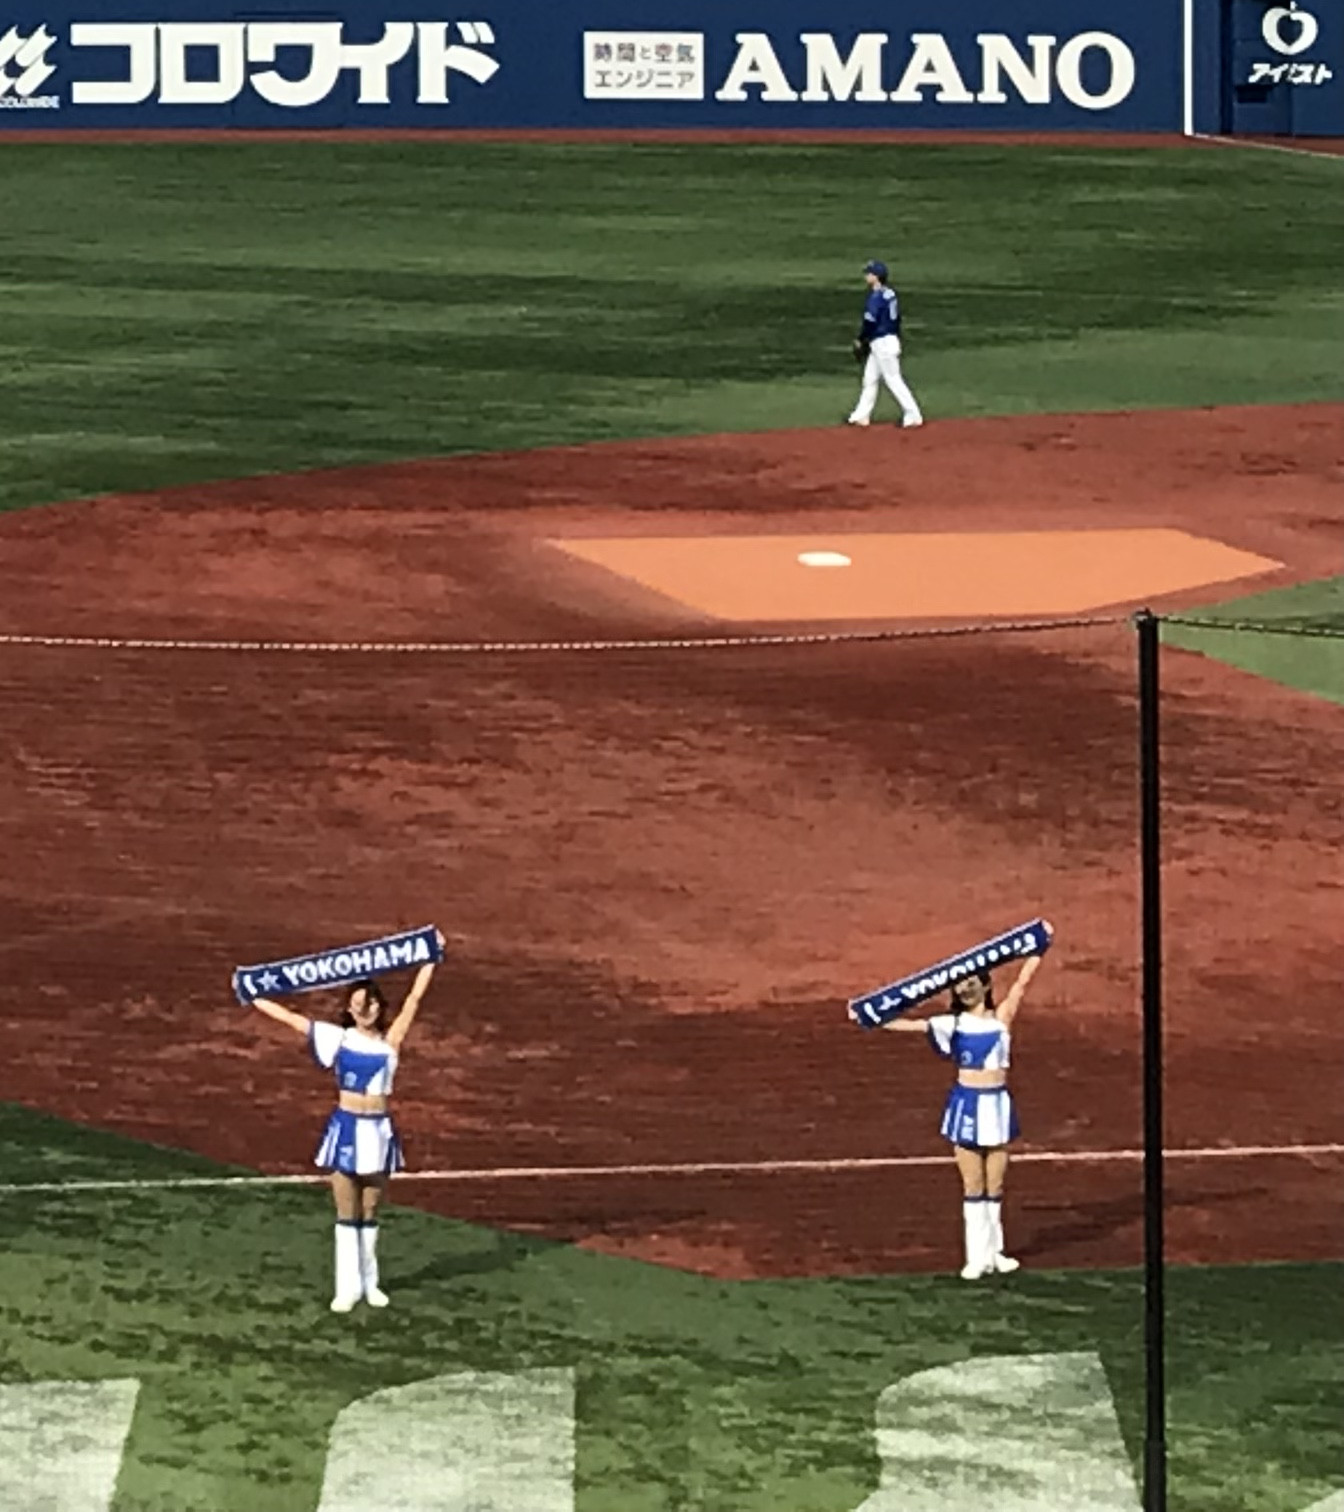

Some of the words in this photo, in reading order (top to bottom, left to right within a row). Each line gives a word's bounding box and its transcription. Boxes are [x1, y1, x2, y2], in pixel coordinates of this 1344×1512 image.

[69, 21, 500, 107] コロワイド
[592, 42, 696, 65] 時間と空気
[714, 30, 1136, 110] AMANO
[593, 68, 695, 90] エンジニア
[282, 937, 431, 986] YOKOHAMA
